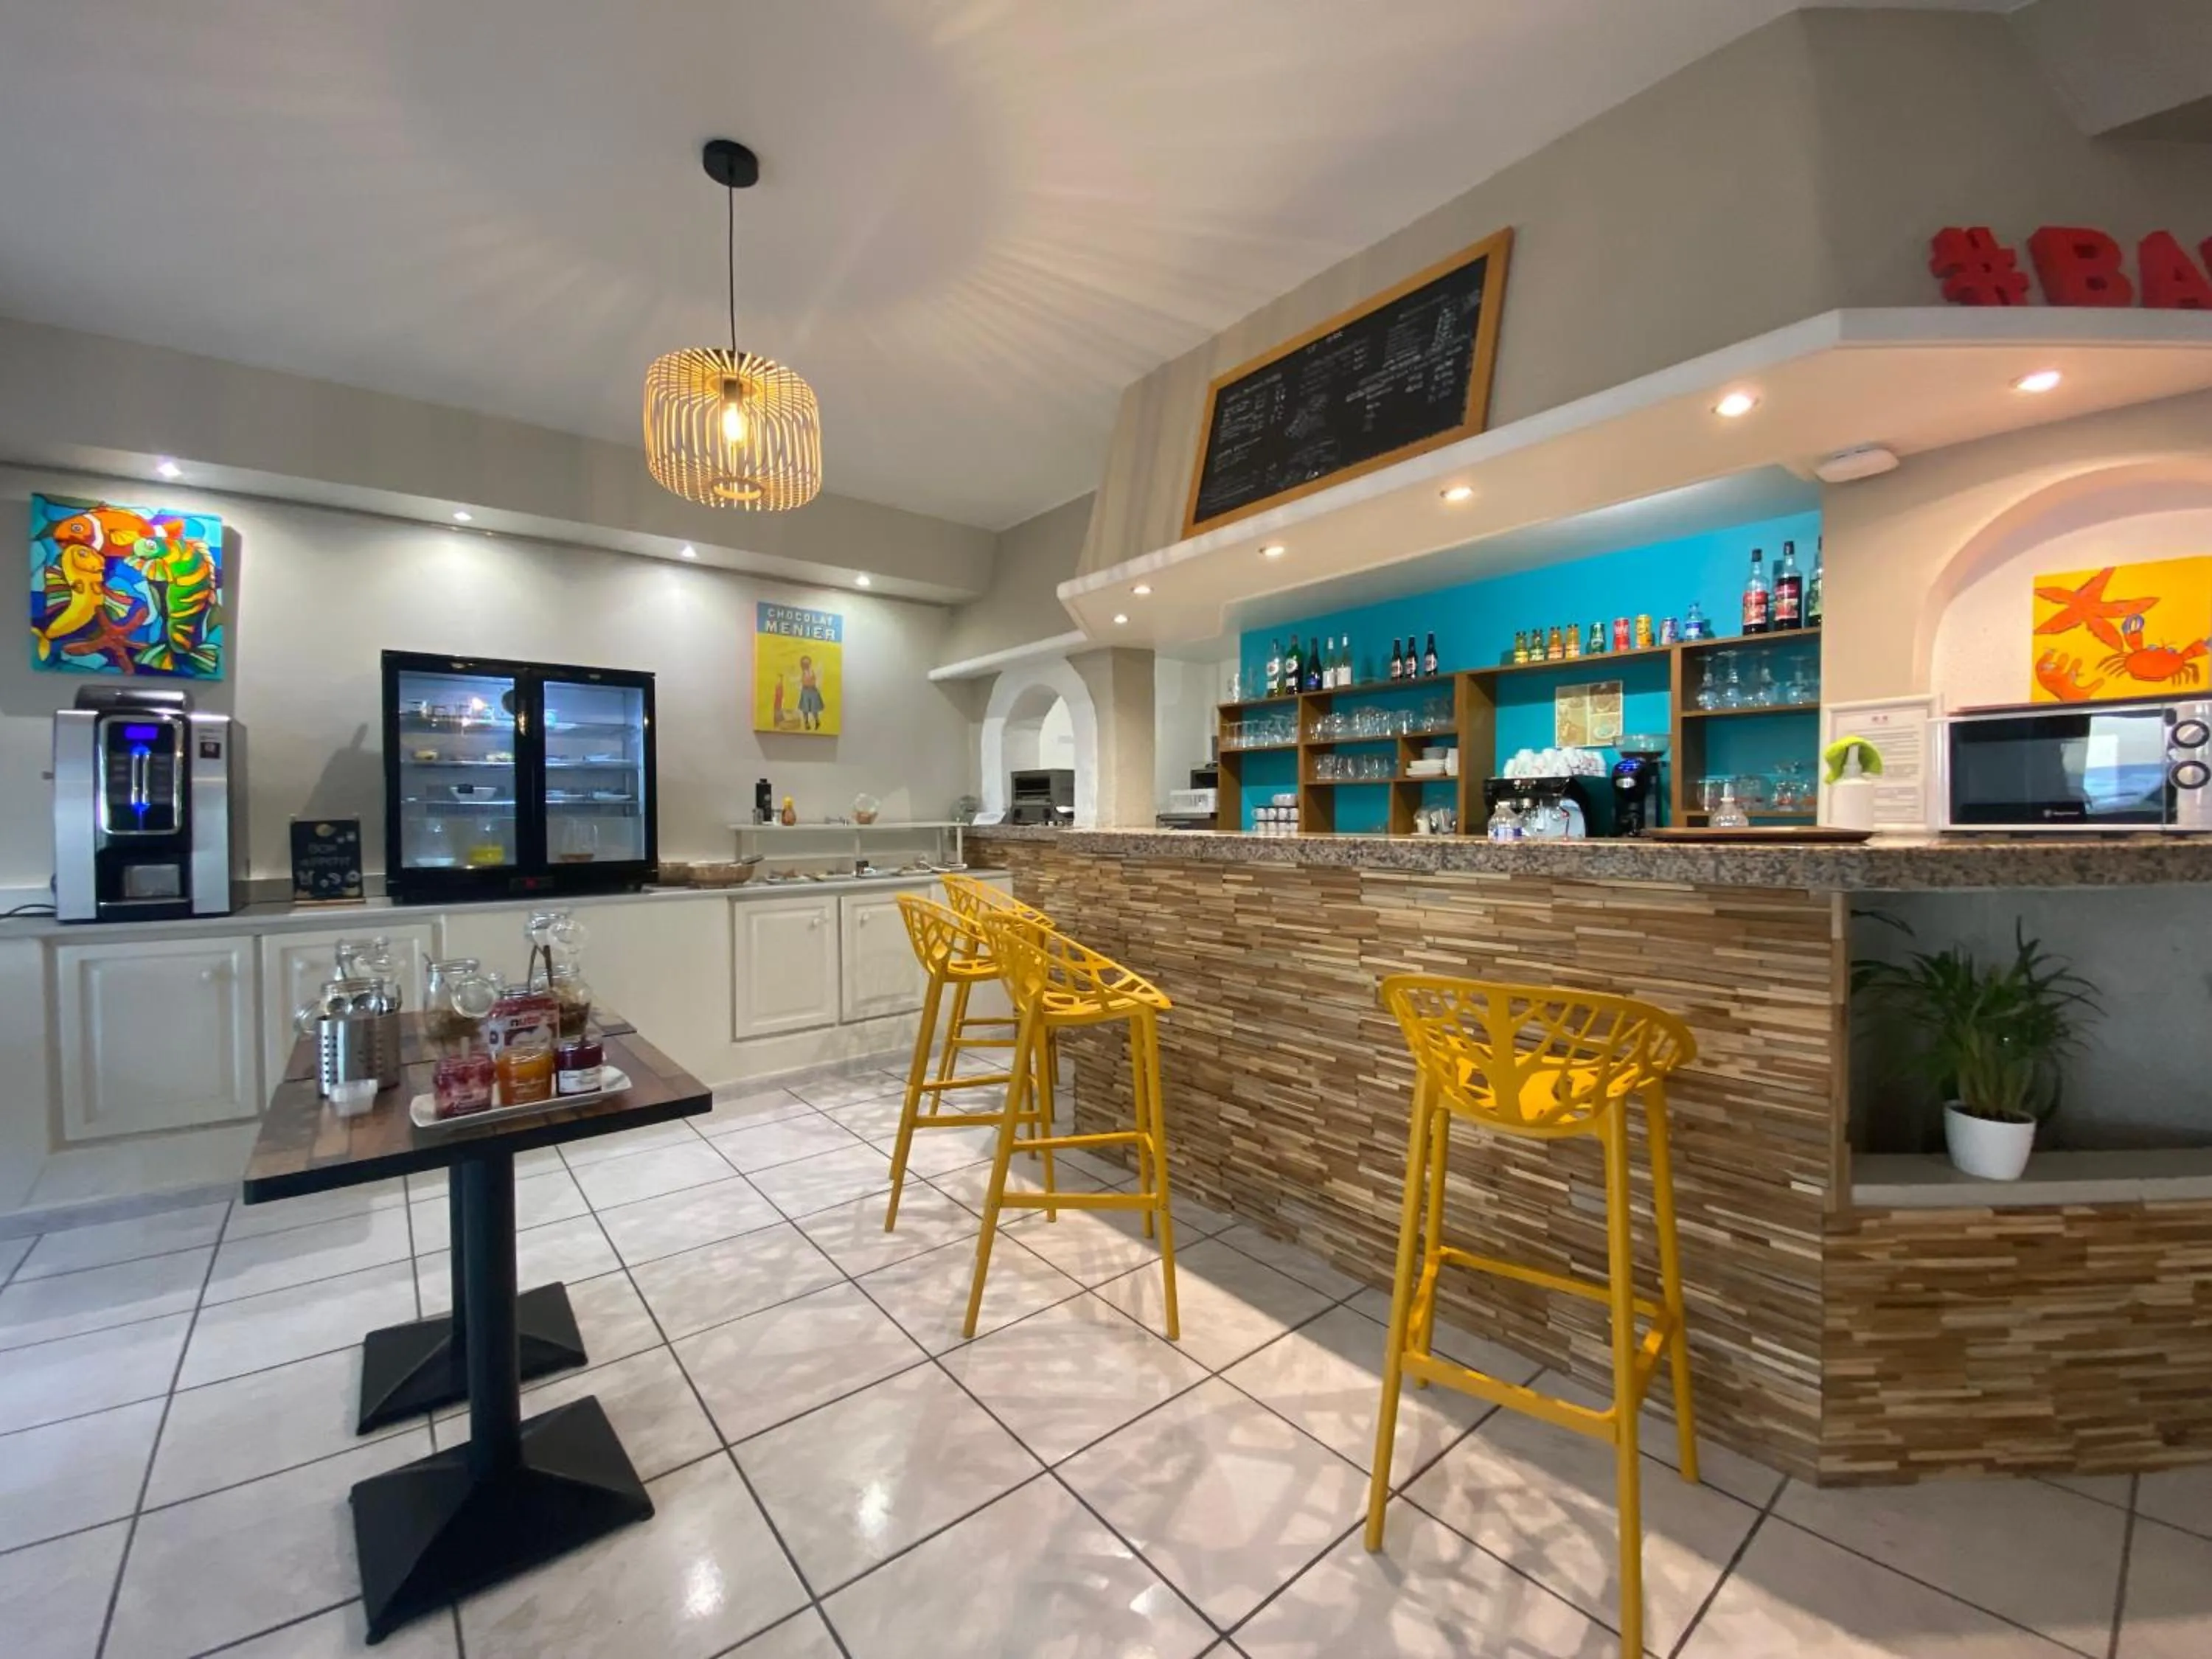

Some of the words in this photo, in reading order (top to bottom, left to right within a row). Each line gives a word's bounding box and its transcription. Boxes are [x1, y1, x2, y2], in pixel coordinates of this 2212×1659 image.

[1929, 226, 2212, 309] #BA
[767, 608, 834, 626] CHOCOLAT
[765, 620, 835, 641] MENIER
